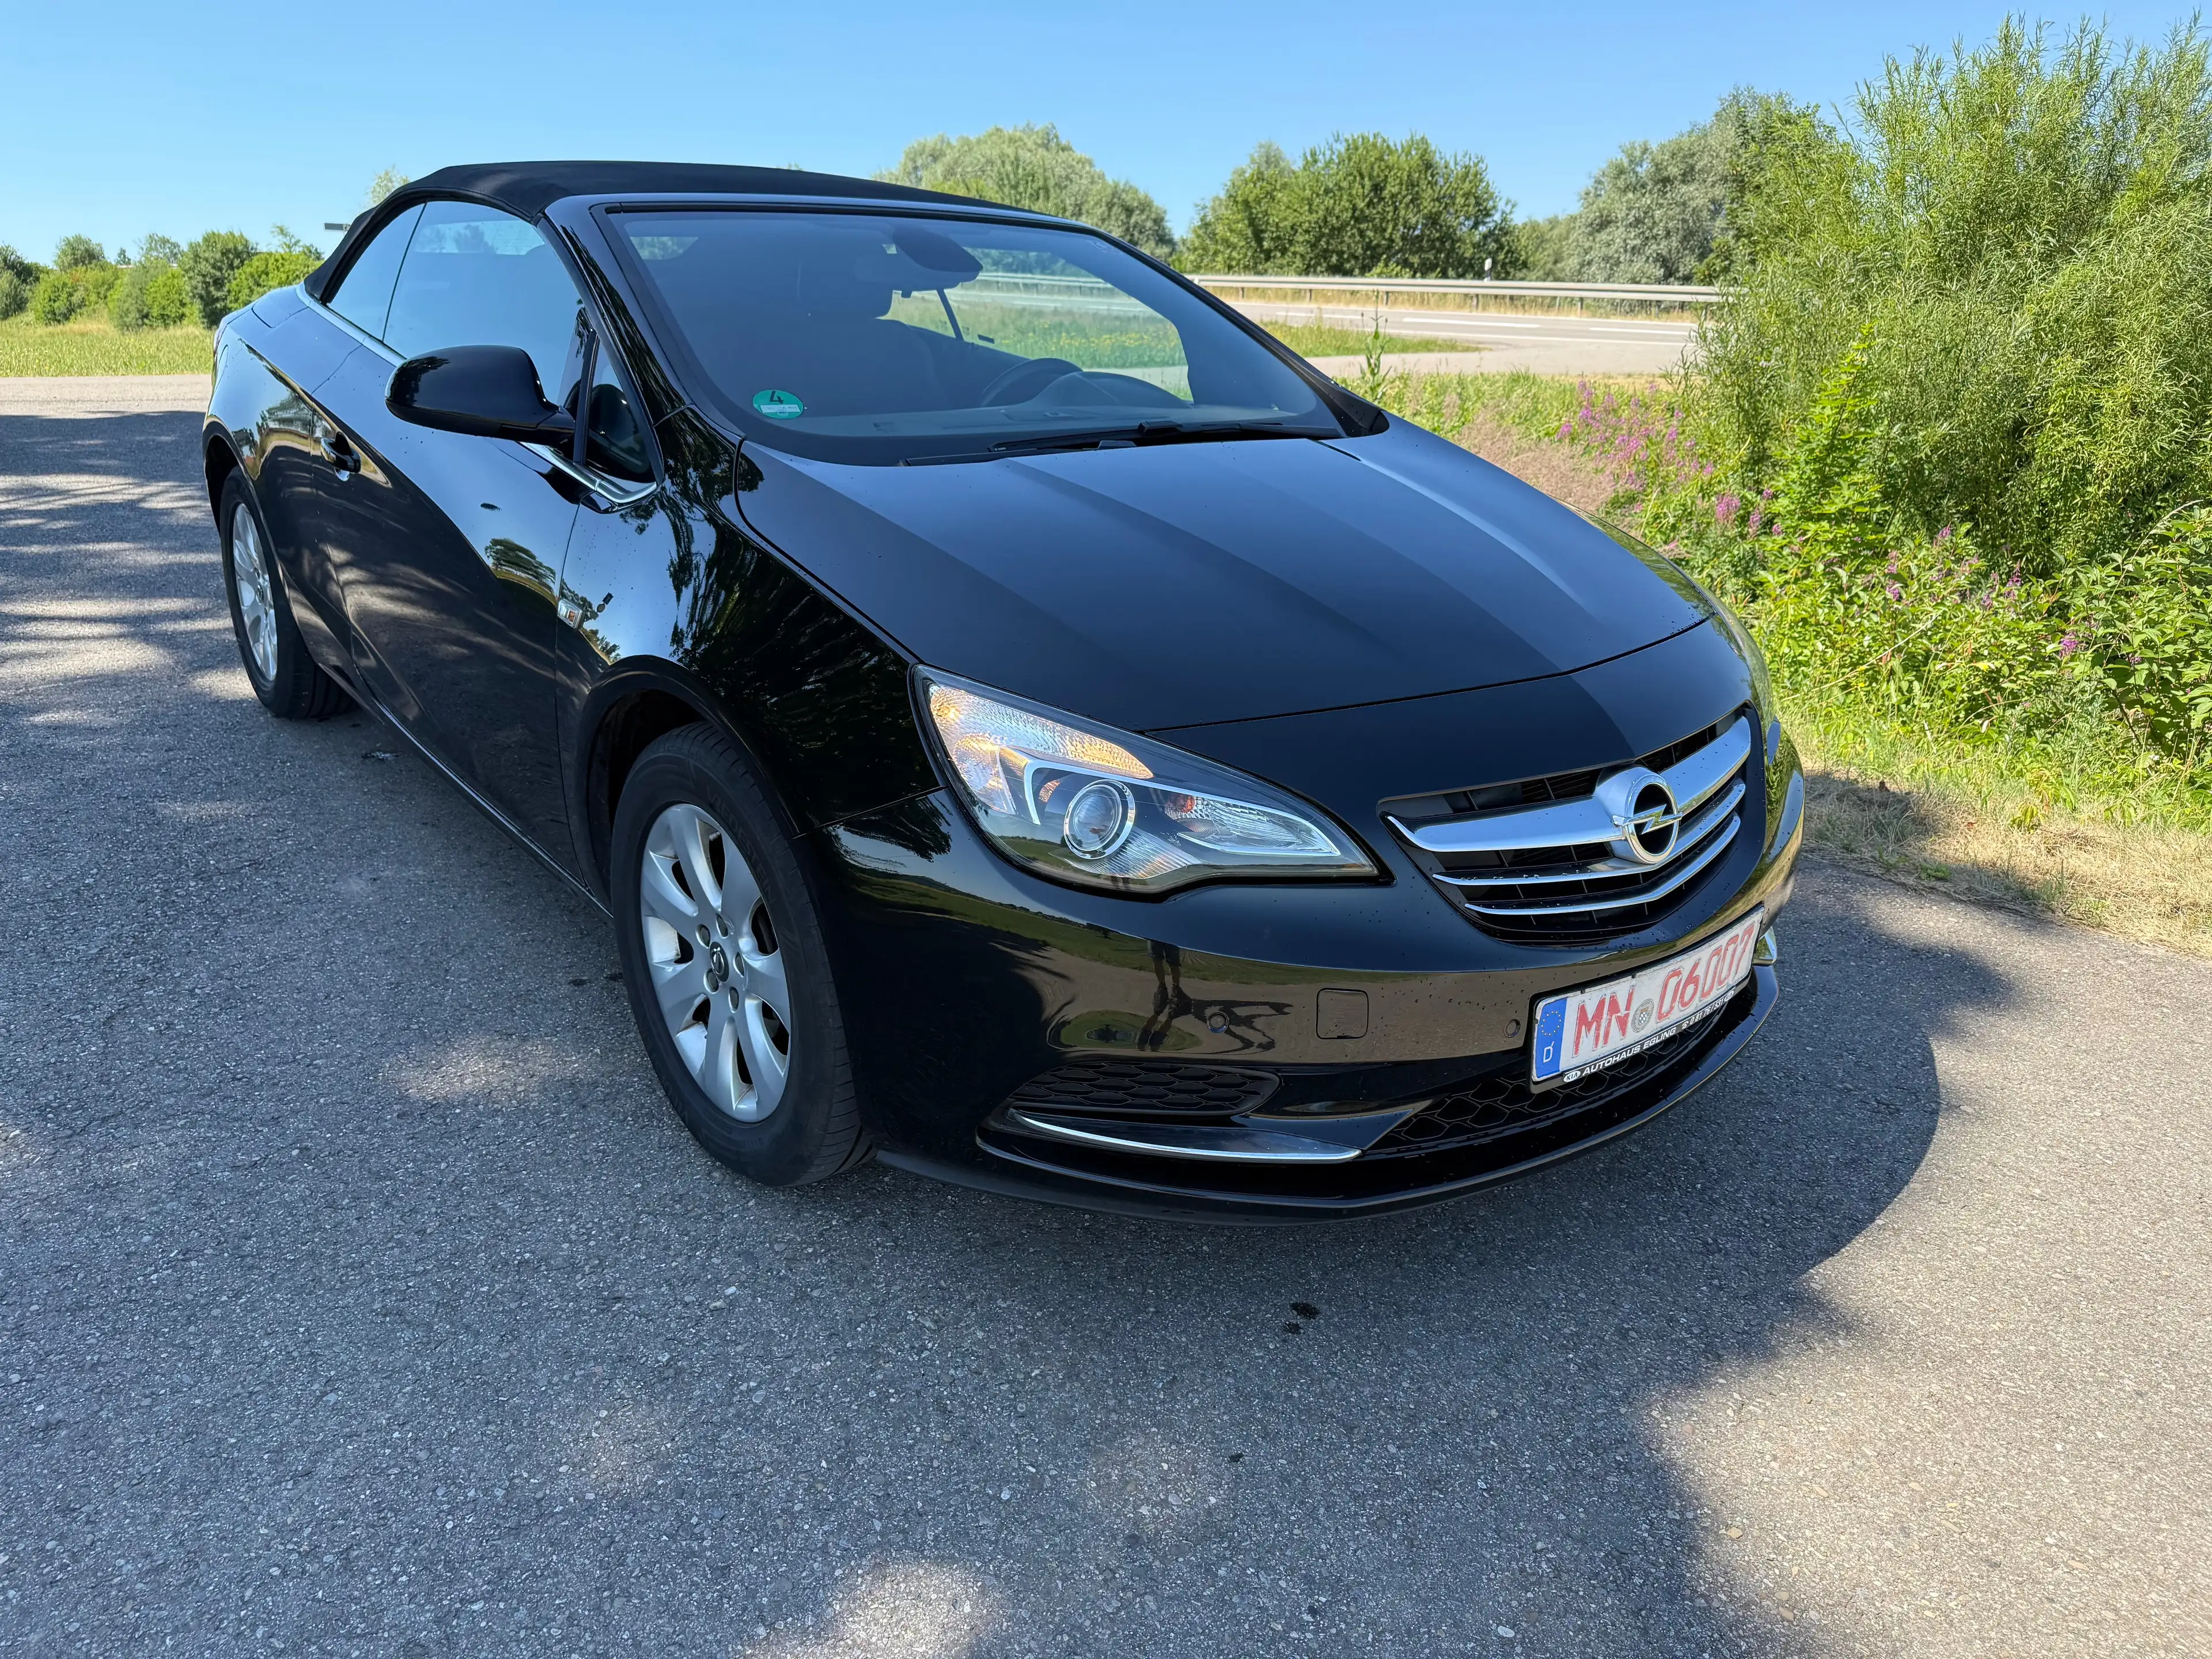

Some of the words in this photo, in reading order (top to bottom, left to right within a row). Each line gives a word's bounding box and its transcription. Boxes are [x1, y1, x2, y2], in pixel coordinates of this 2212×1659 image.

[770, 390, 784, 404] 4
[1573, 986, 1636, 1058] MN
[1656, 923, 1756, 1023] 06007
[1543, 1045, 1554, 1063] D
[1582, 1044, 1641, 1076] AUTOHAUS
[1643, 1027, 1677, 1050] EGLING
